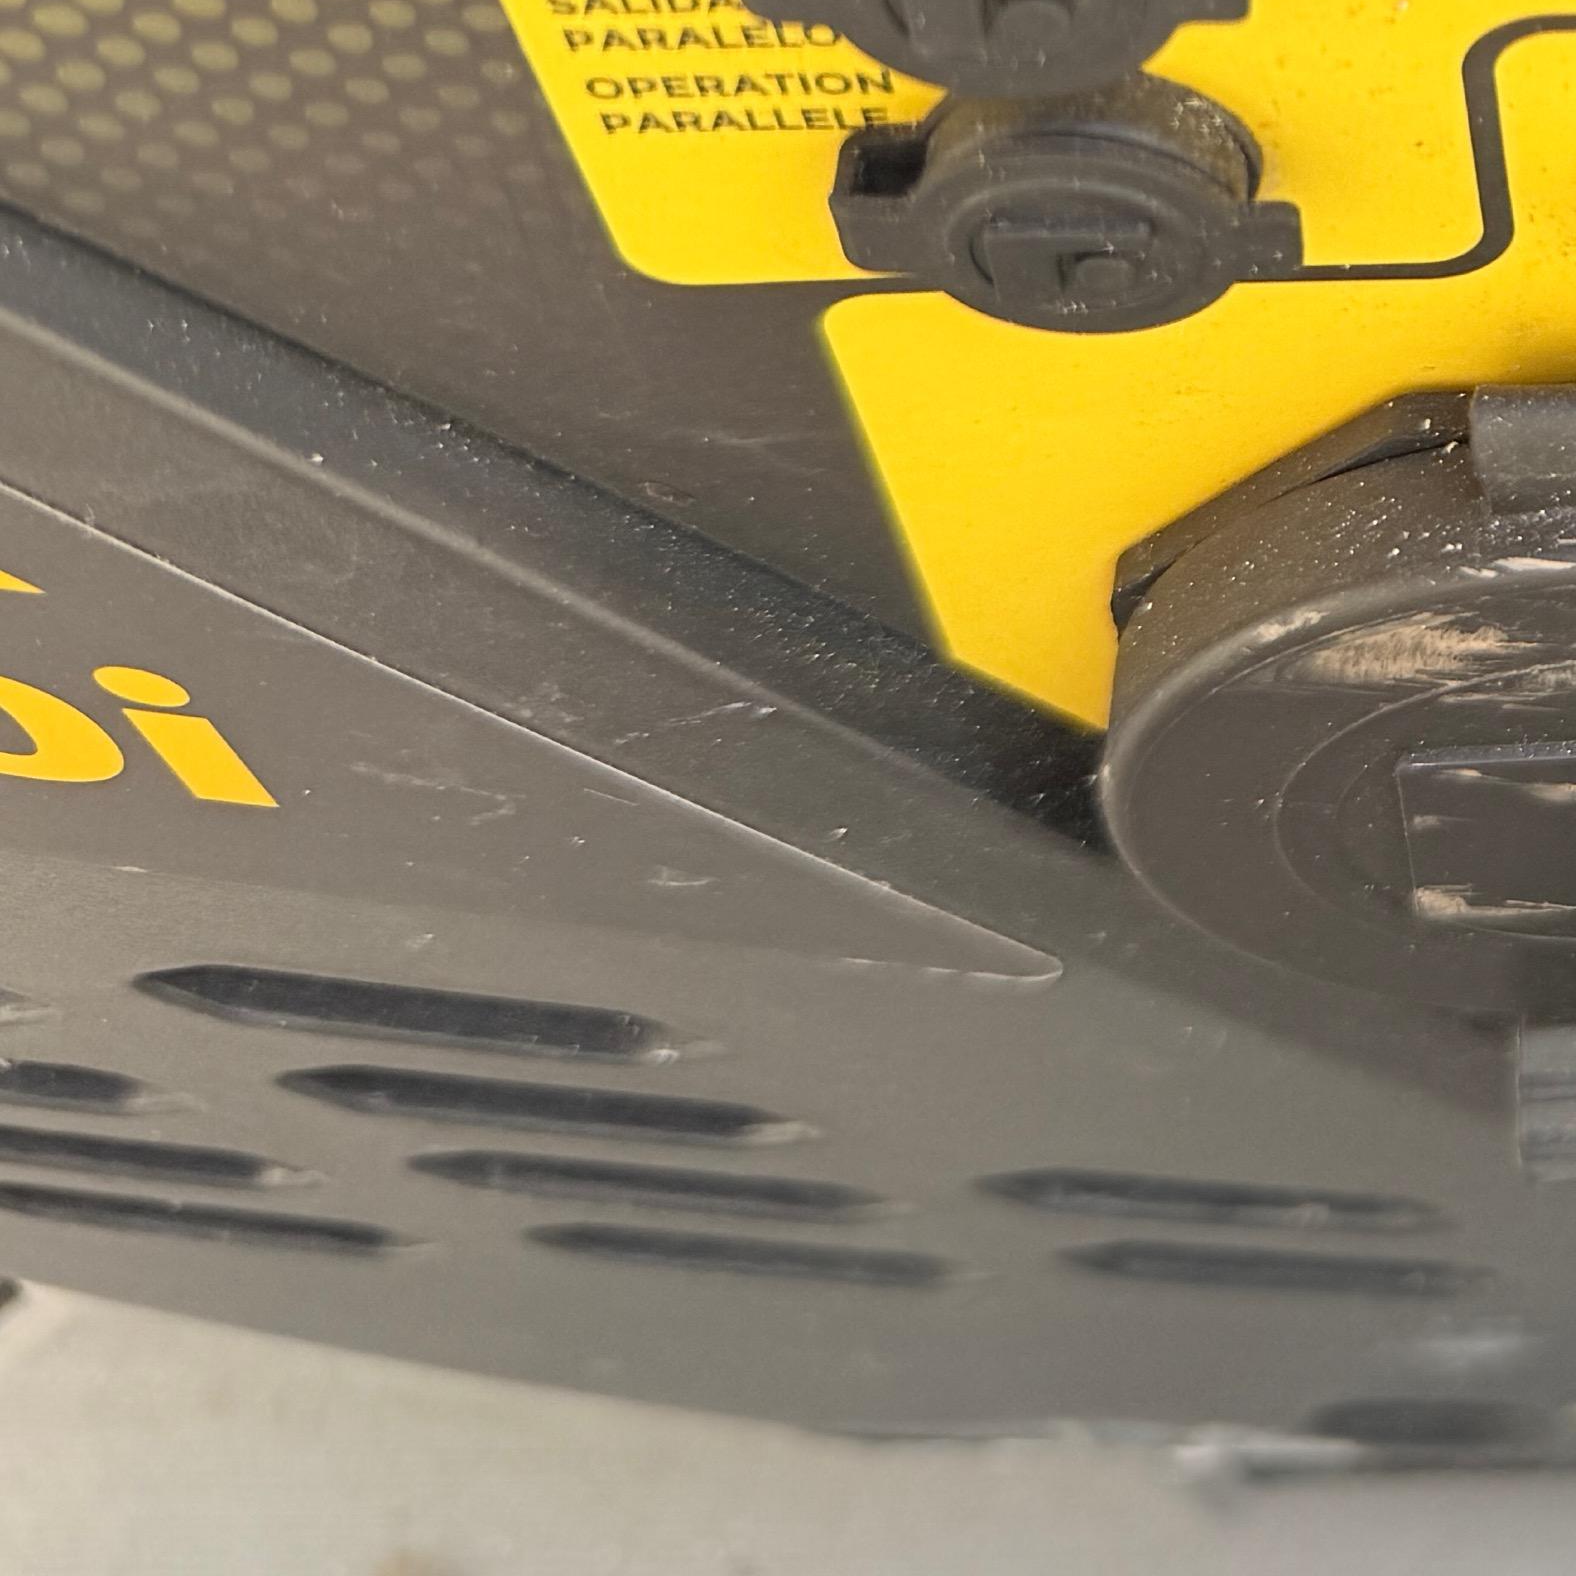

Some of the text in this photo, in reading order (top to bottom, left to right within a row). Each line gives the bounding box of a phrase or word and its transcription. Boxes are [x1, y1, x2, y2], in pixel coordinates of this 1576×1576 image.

[562, 22, 842, 53] PARALELO
[585, 67, 896, 101] OPERATION
[600, 106, 891, 135] PARALLELE
